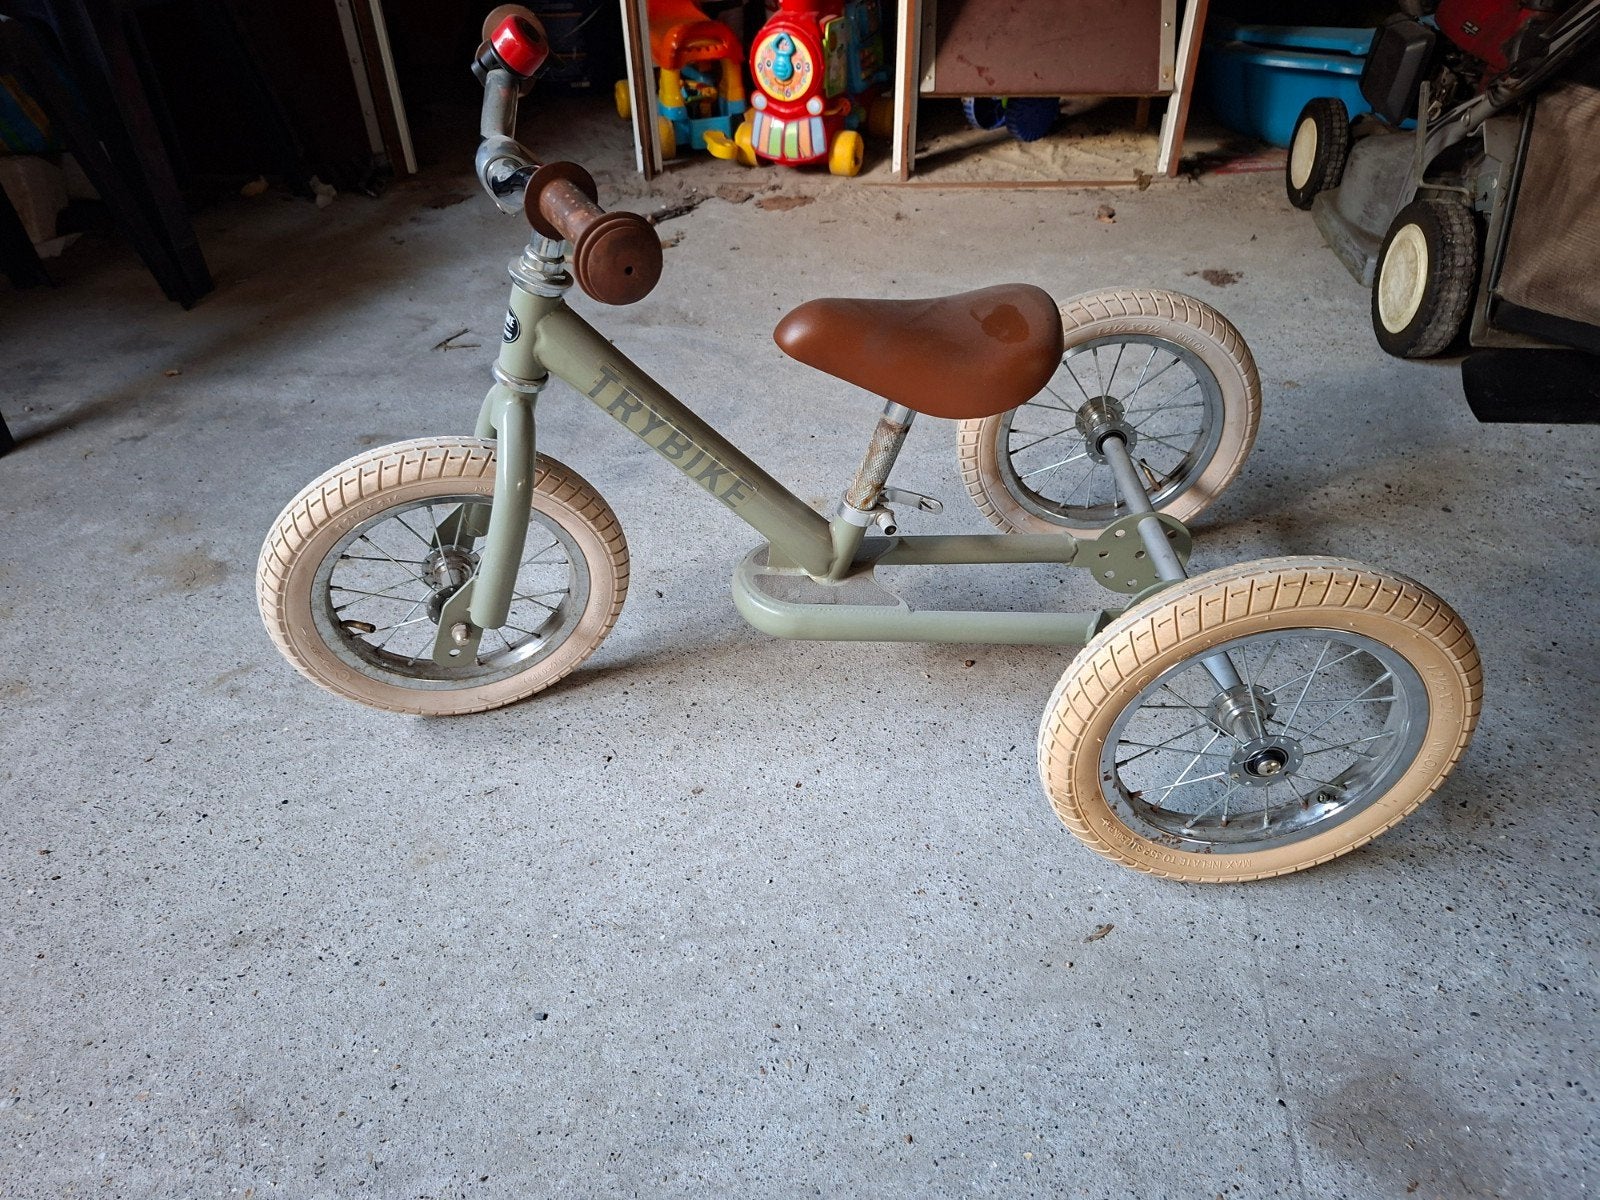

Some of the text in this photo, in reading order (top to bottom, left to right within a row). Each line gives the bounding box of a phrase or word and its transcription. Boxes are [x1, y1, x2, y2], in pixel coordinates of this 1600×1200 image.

[805, 62, 811, 73] 3
[785, 88, 791, 98] 6
[1175, 332, 1207, 352] NYLON
[587, 365, 754, 508] TRYBIKE
[1225, 859, 1252, 869] MAX
